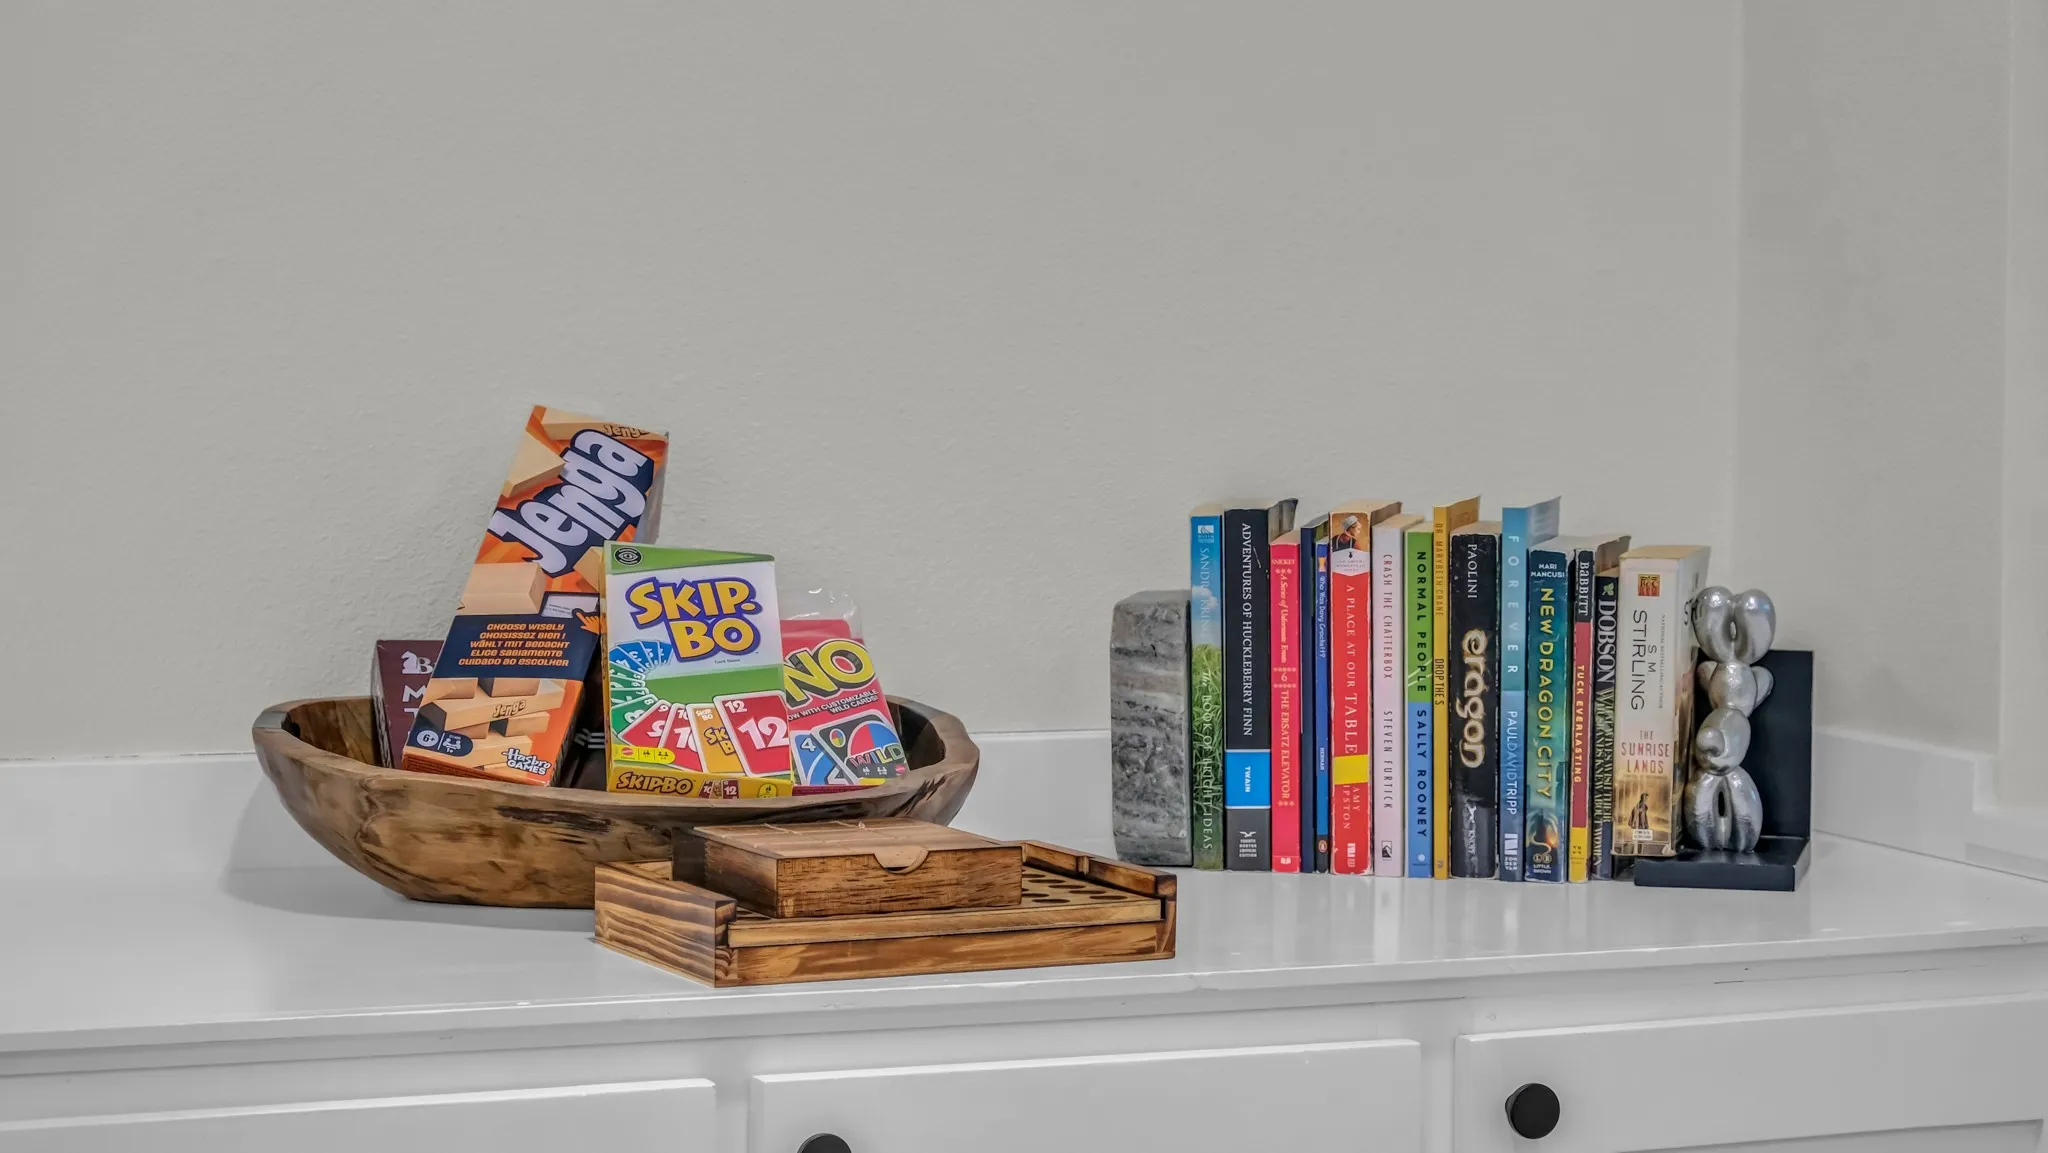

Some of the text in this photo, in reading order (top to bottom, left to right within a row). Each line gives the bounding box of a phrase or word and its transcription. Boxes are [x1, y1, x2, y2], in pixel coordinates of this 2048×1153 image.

[487, 429, 653, 576] Jenga
[1436, 524, 1444, 616] DR MARYBETH CRANE
[1468, 544, 1478, 598] PAOLINI
[1346, 598, 1356, 636] PLACE
[1384, 554, 1392, 679] CRASH THE CHATTERBOX
[1508, 536, 1519, 673] FOREVER
[1242, 523, 1252, 736] ADVENTURES OF HUCKLEBERRY FINN
[1417, 552, 1426, 692] NORMAL PEOPLE
[470, 640, 504, 648] WÄHLT
[1346, 642, 1356, 656] AT
[1597, 600, 1617, 683] DOBSON
[518, 658, 569, 666] ESCOLHER
[783, 640, 874, 704] NO
[1346, 662, 1356, 687] OUR
[1434, 658, 1444, 680] DROP
[1631, 610, 1648, 710] STIRLING
[1281, 672, 1288, 682] 6
[1434, 682, 1444, 698] THE
[724, 700, 748, 714] 12
[800, 708, 821, 716] WITH
[820, 688, 878, 710] CUSTOMIZABLE
[830, 694, 878, 714] WILD CARDS!
[1457, 628, 1488, 768] eragon
[1536, 588, 1554, 799] NEW DRAGON CITY
[492, 700, 526, 718] Jenga
[1202, 694, 1212, 730] BOOK
[1344, 692, 1358, 754] TABLE
[1574, 665, 1584, 782] TUCK EVERLASTING
[719, 740, 736, 756] B
[738, 716, 790, 750] 12
[801, 738, 816, 752] 4
[1281, 690, 1290, 798] THE ERSATZ ELEVATOR
[1604, 730, 1614, 760] WIVES
[1640, 730, 1654, 740] THE
[502, 748, 551, 769] Hasbro
[850, 744, 903, 767] WILD
[1384, 711, 1392, 808] STEVEN FURTICK
[1621, 742, 1670, 757] SUNRISE
[507, 758, 546, 775] GAMES
[1417, 710, 1427, 838] SALLY ROONEY
[1595, 760, 1604, 789] KNEW
[1604, 762, 1614, 789] WISH
[1627, 760, 1664, 774] LANDS
[724, 786, 737, 796] 12
[1594, 793, 1604, 823] ABOUT
[1603, 792, 1613, 822] THEIR
[1202, 812, 1212, 850] IDEAS
[1594, 826, 1603, 865] WOMEN
